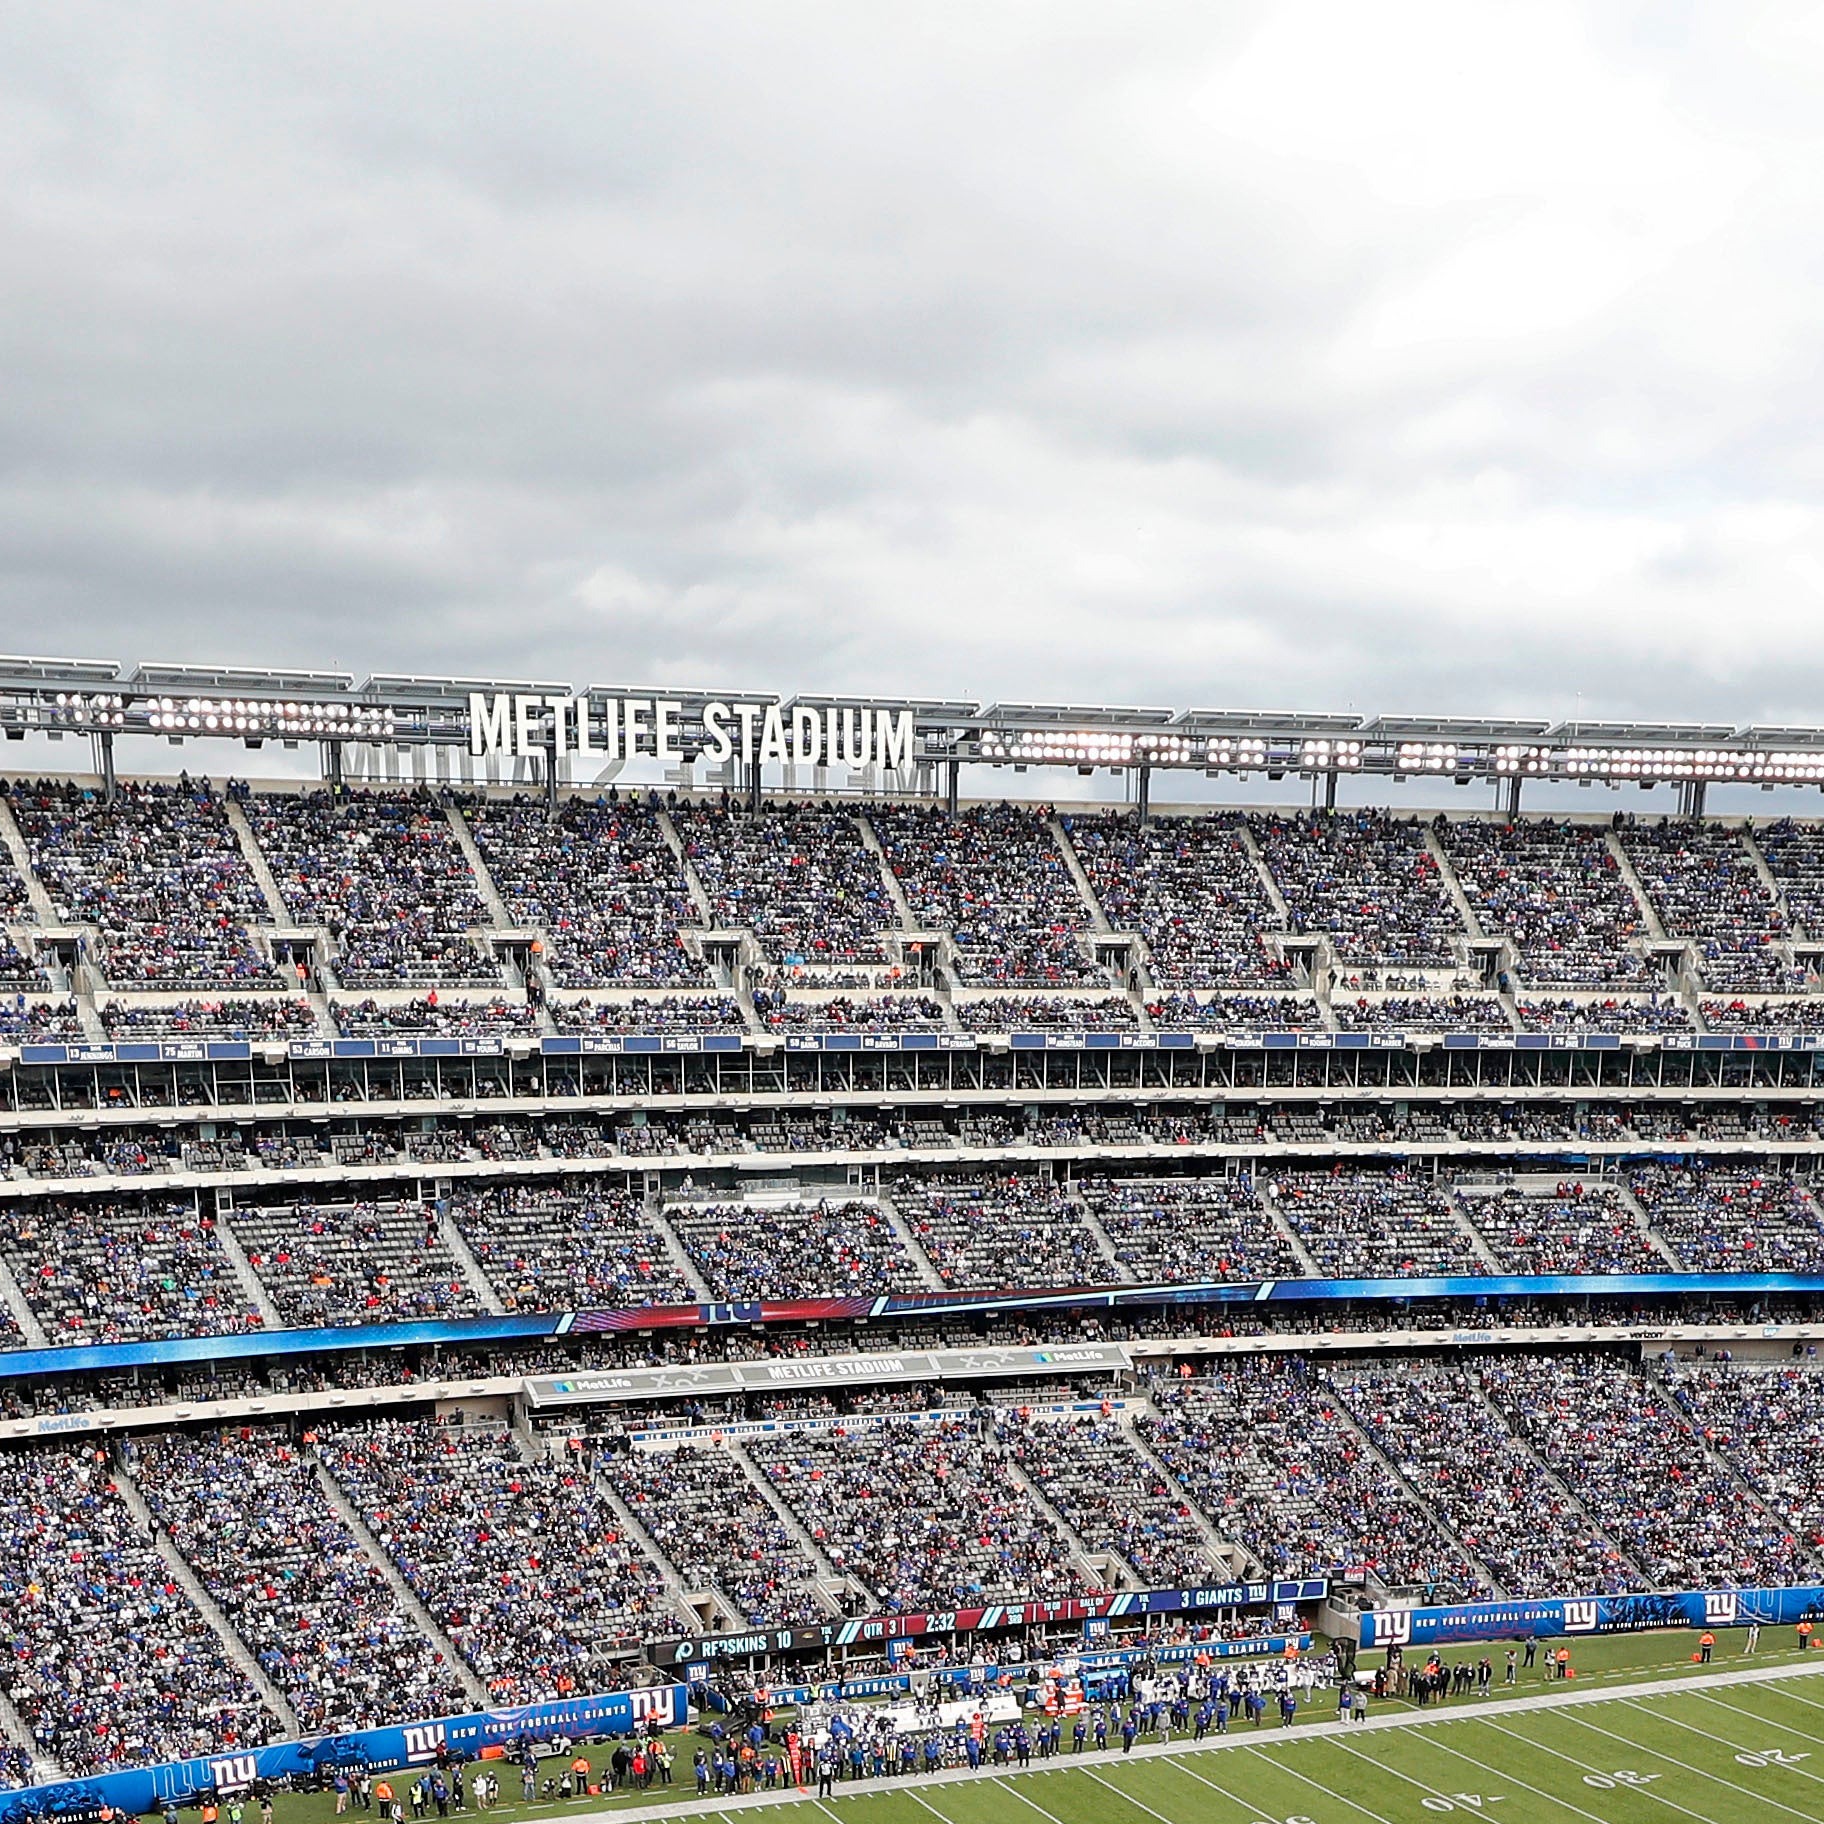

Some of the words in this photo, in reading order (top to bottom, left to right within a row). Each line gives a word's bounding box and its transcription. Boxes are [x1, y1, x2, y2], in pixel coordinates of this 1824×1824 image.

[469, 692, 683, 762] METLIFE
[702, 701, 914, 768] STADIUM
[1630, 1331, 1665, 1339] verizon
[1053, 1351, 1103, 1362] MetLife
[768, 1362, 836, 1380] METLIFE
[837, 1359, 904, 1376] STADIUM
[577, 1378, 632, 1391] MetLife
[38, 1417, 90, 1432] MetLife
[1181, 1590, 1189, 1607] 3
[1196, 1588, 1242, 1606] GIANTS
[1296, 1583, 1304, 1598] 7
[926, 1611, 955, 1632] 2:32
[1416, 1618, 1436, 1627] NEW
[1442, 1615, 1467, 1626] YORK
[1471, 1612, 1518, 1624] FOOTBALL
[1524, 1609, 1560, 1620] GIANTS
[864, 1623, 883, 1638] QTR
[889, 1619, 896, 1634] 3
[776, 1630, 791, 1648] 10
[1228, 1641, 1268, 1655] GIANTS
[770, 1693, 794, 1705] NEW
[841, 1679, 902, 1698] FOOTBALL
[453, 1726, 477, 1738] NEW
[485, 1722, 513, 1735] YORK
[521, 1713, 578, 1729] FOOTBALL
[585, 1705, 627, 1720] GIANTS
[1735, 1750, 1801, 1769] 20
[1583, 1770, 1653, 1791] 30
[1421, 1792, 1486, 1813] 40
